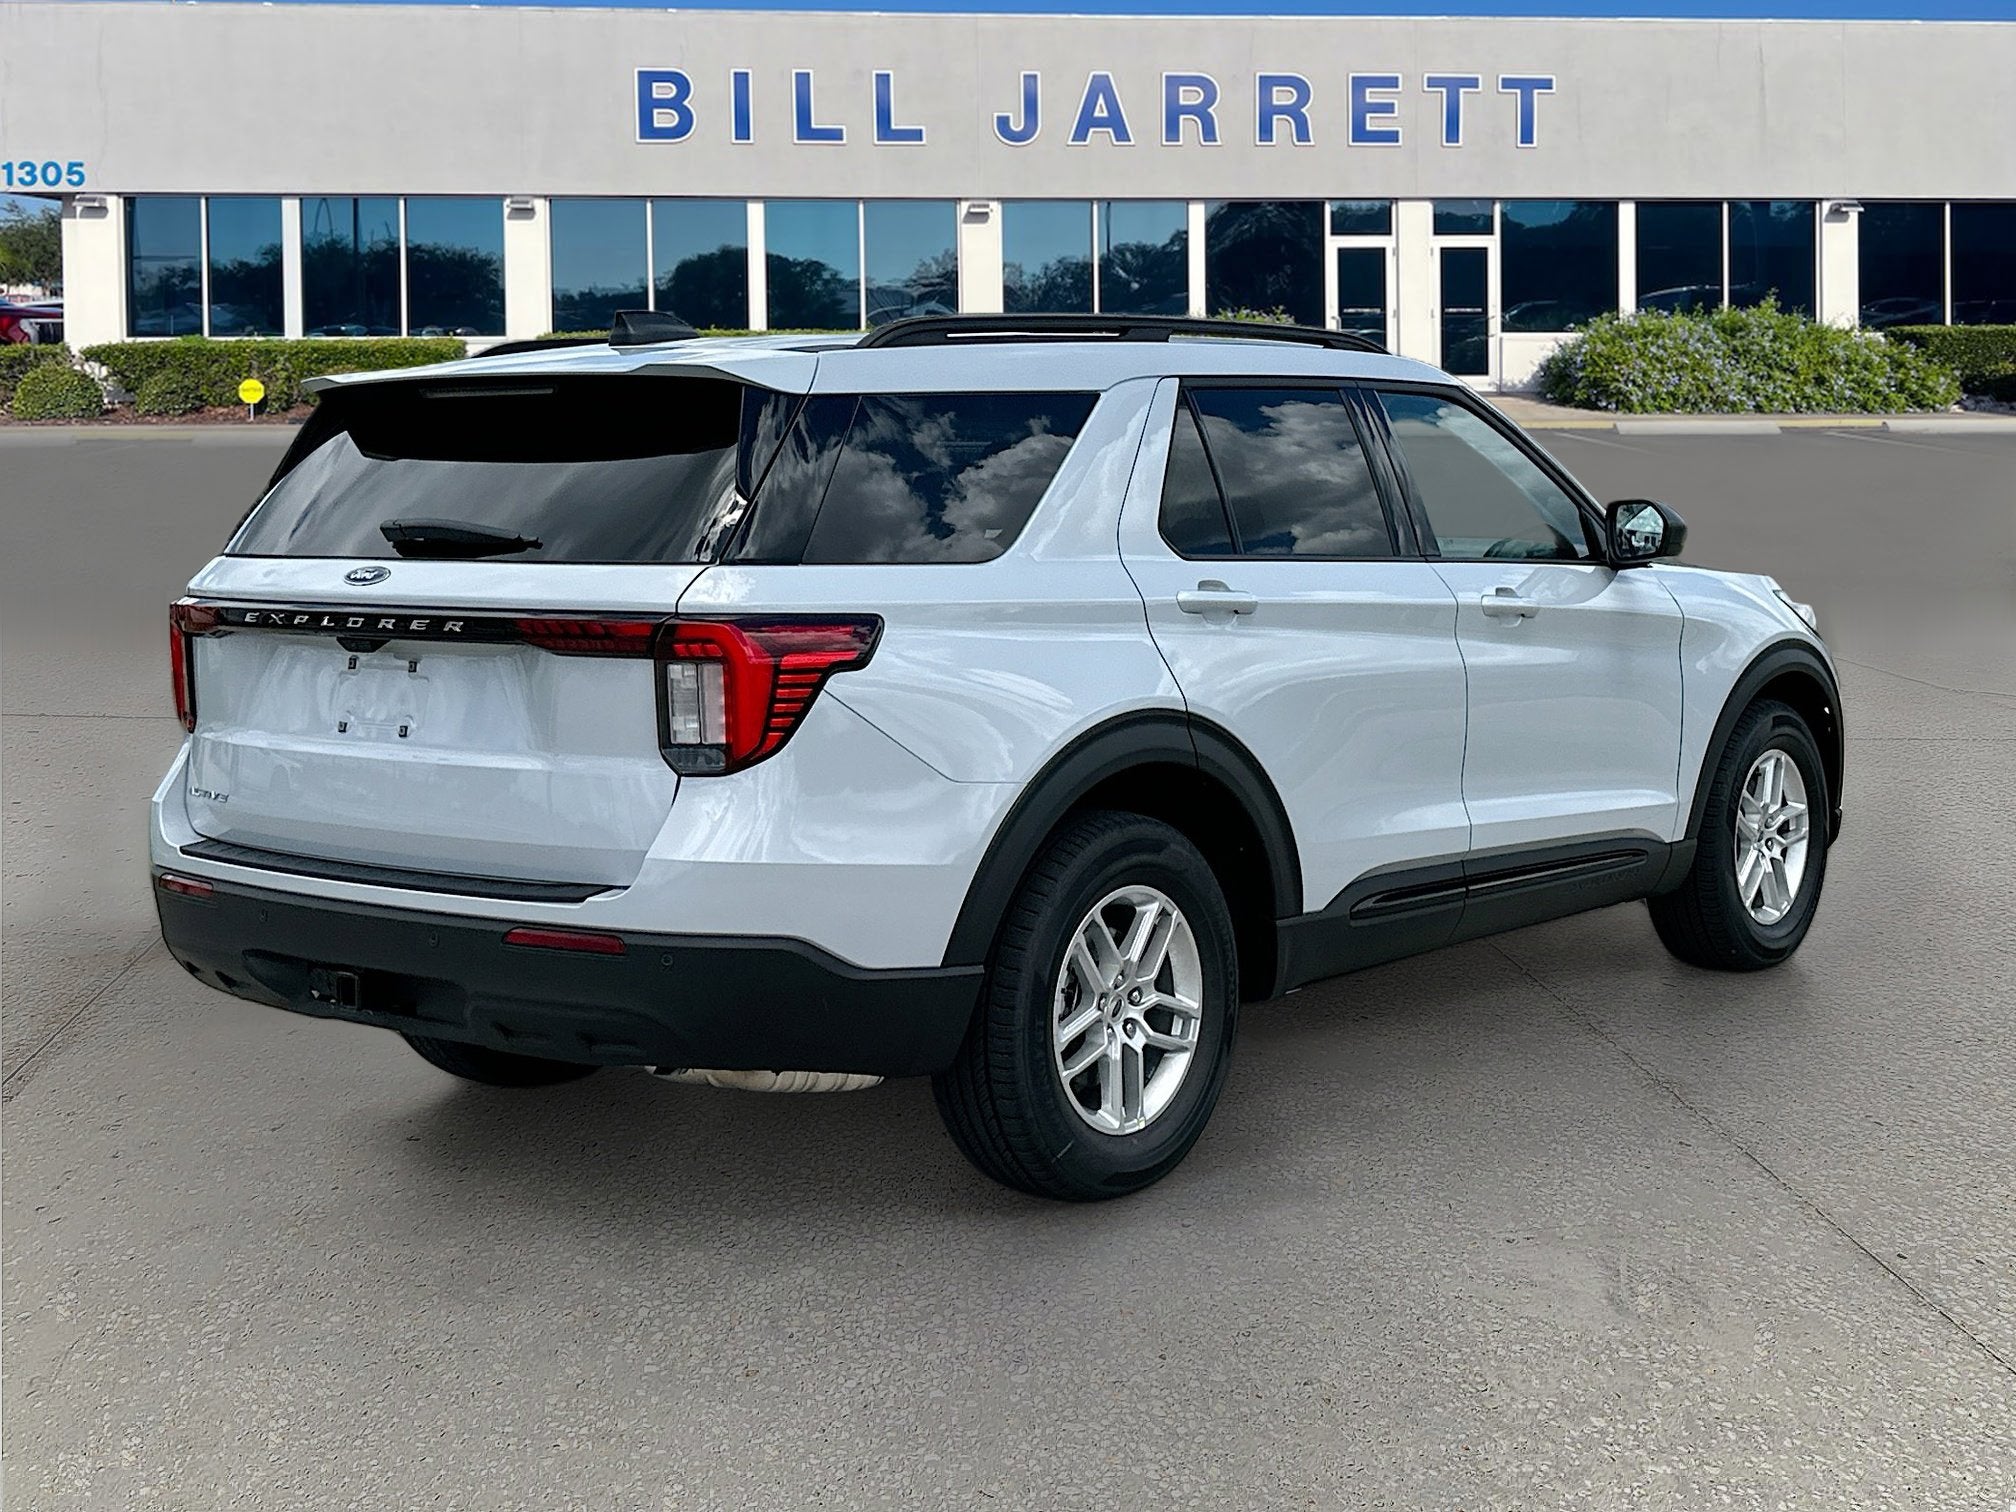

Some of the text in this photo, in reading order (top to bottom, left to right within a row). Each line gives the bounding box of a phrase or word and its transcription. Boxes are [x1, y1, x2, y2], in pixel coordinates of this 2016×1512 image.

[634, 68, 1556, 148] BILL JARRETT
[1, 160, 86, 187] 1305
[244, 612, 465, 633] EXPLORER
